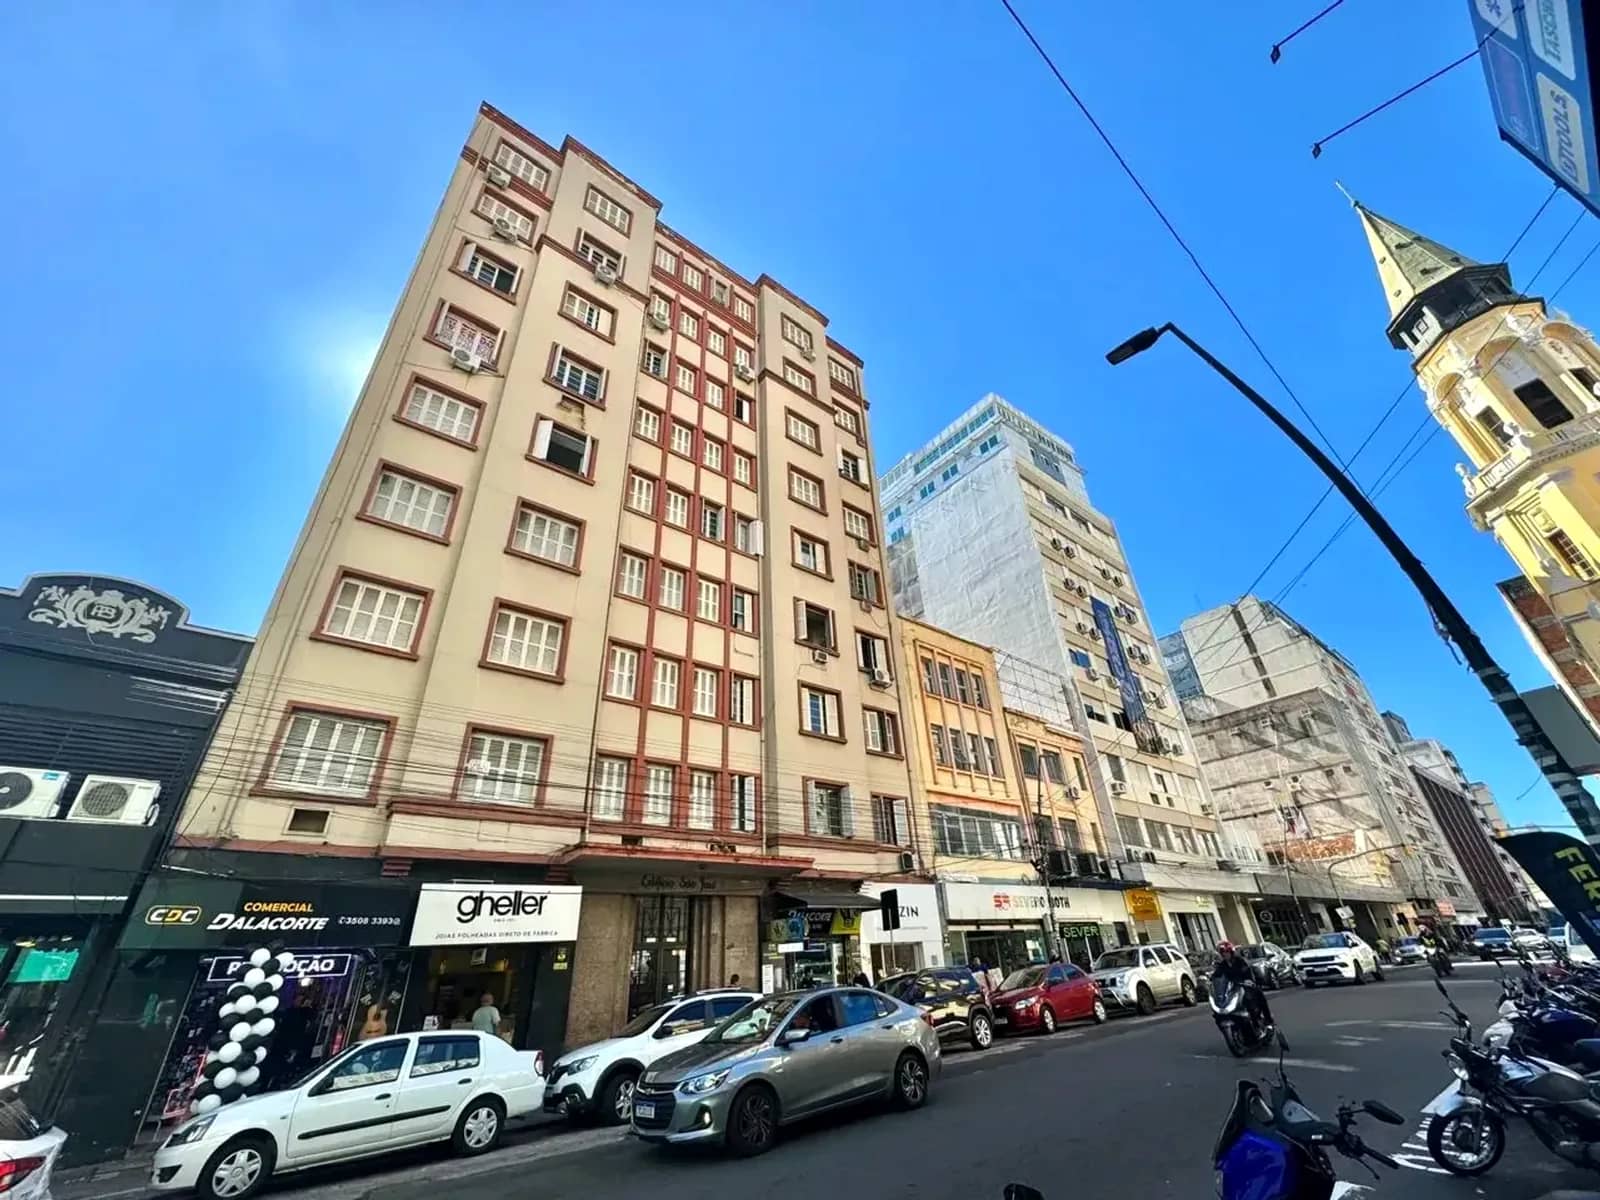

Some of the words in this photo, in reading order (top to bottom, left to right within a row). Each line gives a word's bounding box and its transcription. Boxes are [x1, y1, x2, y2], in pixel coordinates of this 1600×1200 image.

[1553, 846, 1600, 913] FER
[149, 908, 199, 922] CDC
[243, 902, 314, 913] COMERCIAL
[456, 890, 548, 924] gheller
[206, 913, 330, 930] DALACORTE
